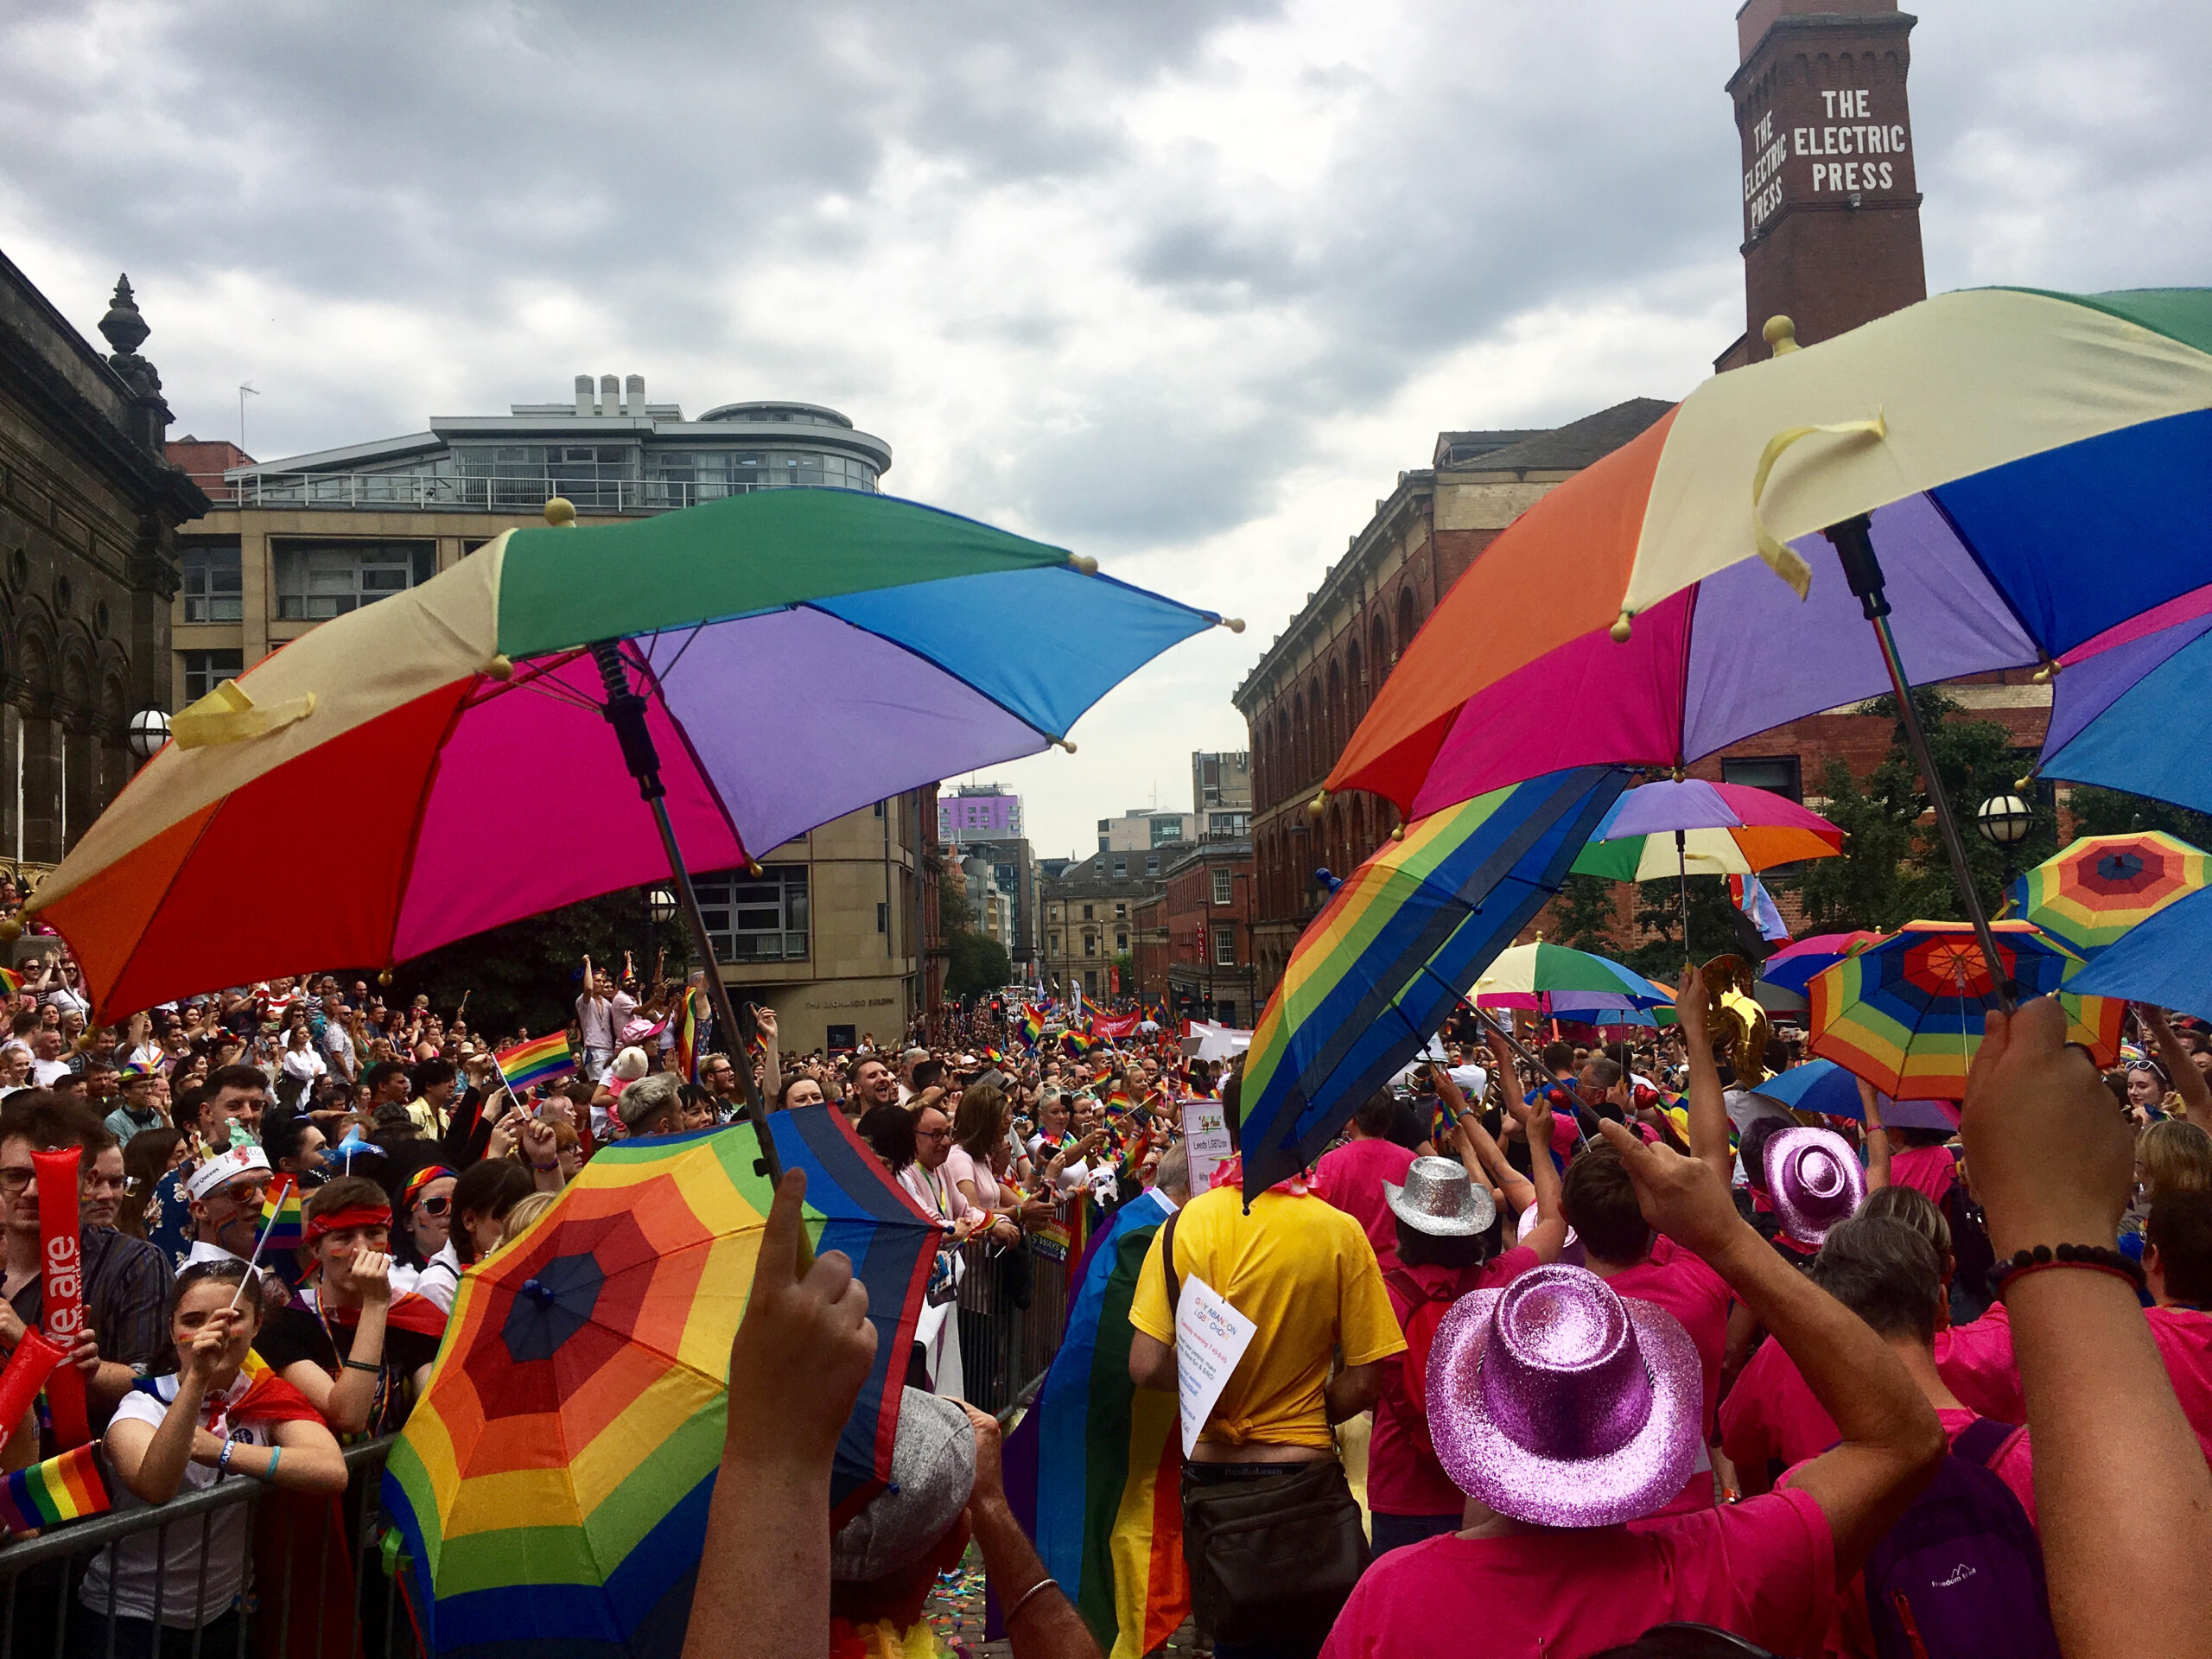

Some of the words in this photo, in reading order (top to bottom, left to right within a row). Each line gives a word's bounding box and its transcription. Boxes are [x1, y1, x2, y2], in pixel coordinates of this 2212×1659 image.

[1821, 89, 1872, 118] THE
[1753, 109, 1774, 154] THE
[1794, 124, 1906, 156] ELECTRIC
[1745, 133, 1787, 201] ELECTRIC
[1812, 162, 1894, 192] PRESS
[1751, 175, 1783, 228] PRESS
[199, 1166, 219, 1184] Queens
[48, 1236, 77, 1298] are
[73, 1249, 84, 1332] antander
[1194, 1308, 1211, 1323] LGBT
[1210, 1322, 1230, 1341] CHOIR
[1195, 1297, 1209, 1311] GAY
[1207, 1307, 1237, 1336] ABANDON
